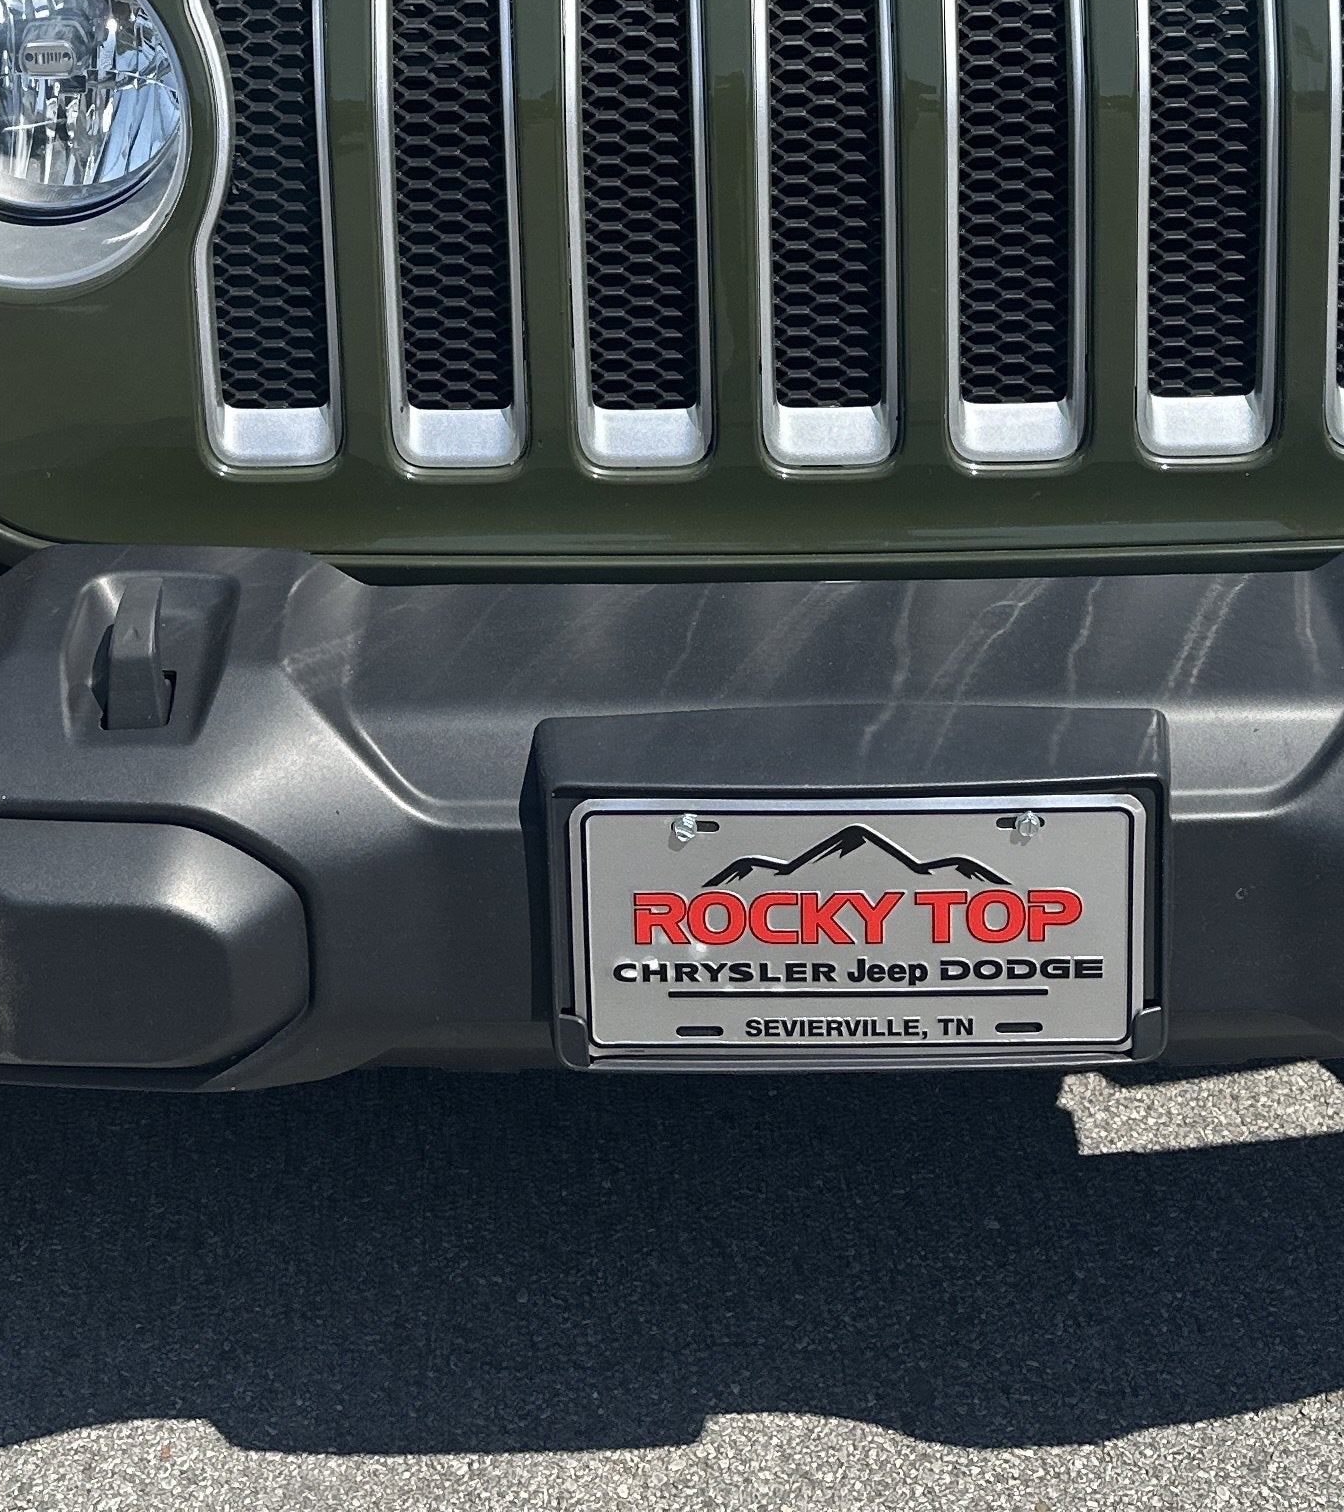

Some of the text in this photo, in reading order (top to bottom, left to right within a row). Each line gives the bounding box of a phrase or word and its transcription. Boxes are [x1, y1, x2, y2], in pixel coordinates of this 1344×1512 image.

[633, 888, 1083, 945] ROCKY TOP
[612, 957, 1105, 986] CHRYSLER Jeep DODGE
[745, 1018, 975, 1040] SEVIERVILLE, TN
